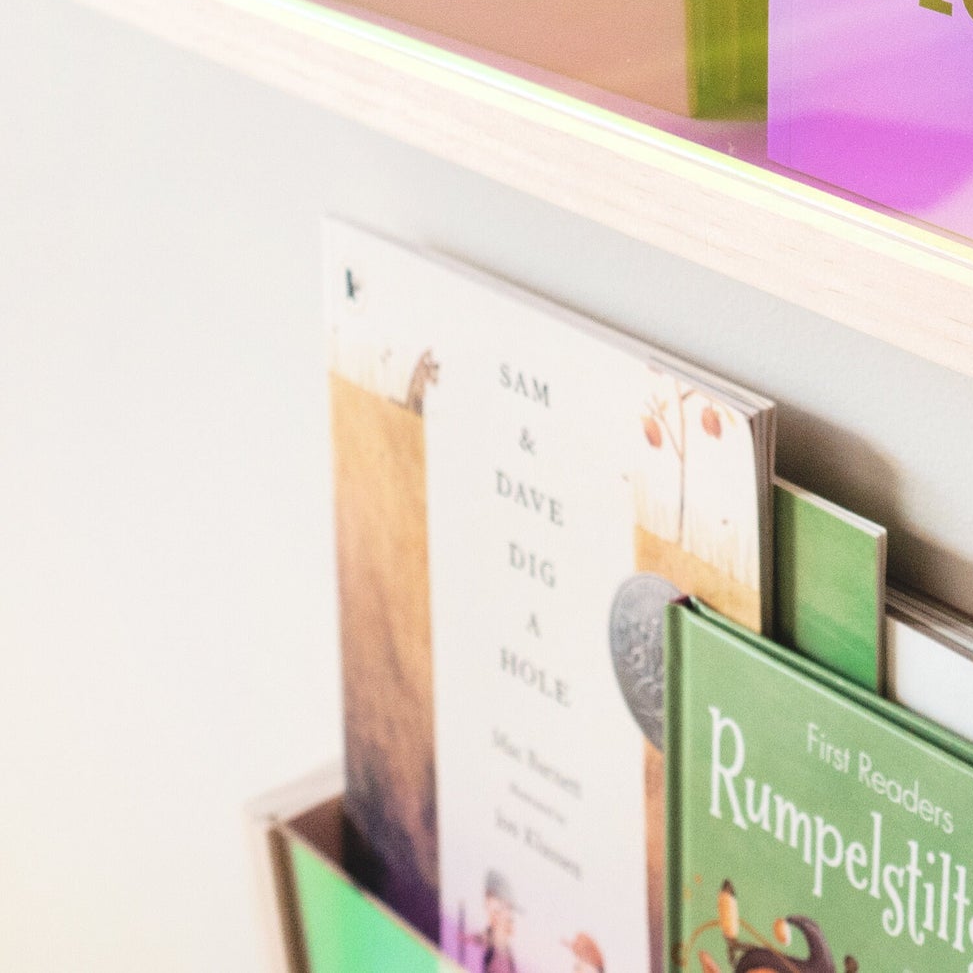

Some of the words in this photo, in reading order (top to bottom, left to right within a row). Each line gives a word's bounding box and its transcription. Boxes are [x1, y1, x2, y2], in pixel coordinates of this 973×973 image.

[499, 363, 551, 409] SAM
[518, 427, 536, 456] &
[495, 469, 564, 527] DAVE
[508, 541, 556, 589] DIG
[527, 612, 542, 639] A
[500, 647, 572, 708] HOLE
[807, 722, 850, 774] First
[858, 751, 954, 834] Readers
